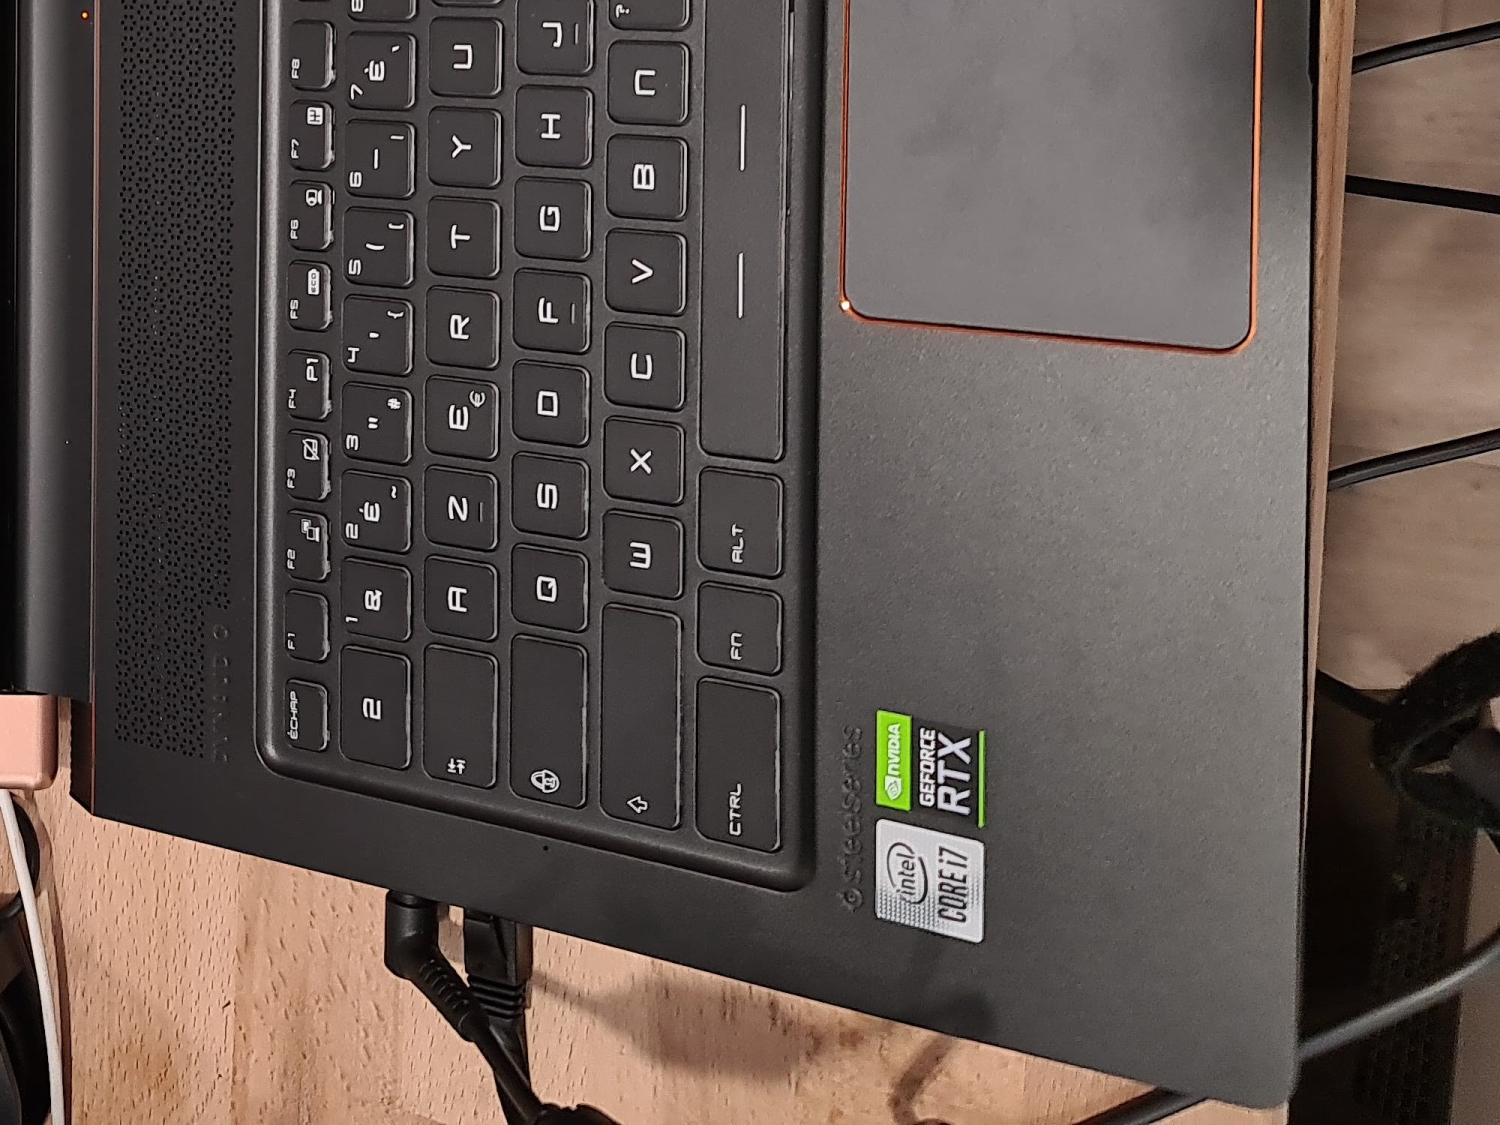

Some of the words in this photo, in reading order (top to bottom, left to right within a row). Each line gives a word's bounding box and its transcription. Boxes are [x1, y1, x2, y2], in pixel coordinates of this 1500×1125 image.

[543, 23, 562, 47] J
[292, 59, 299, 78] F8
[454, 45, 472, 68] U
[365, 61, 384, 80] È
[351, 85, 362, 99] 7
[542, 114, 560, 138] H
[291, 139, 299, 158] F7
[452, 136, 471, 158] Y
[350, 172, 361, 187] 6
[634, 164, 654, 189] B
[291, 220, 298, 239] F6
[540, 206, 559, 231] G
[451, 225, 470, 248] T
[349, 260, 361, 274] 5
[632, 260, 652, 283] V
[290, 300, 298, 319] F5
[539, 298, 558, 323] F
[450, 315, 469, 339] R
[348, 348, 359, 362] 4
[631, 354, 652, 379] C
[307, 359, 318, 381] P1
[289, 389, 296, 408] F4
[538, 391, 557, 416] D
[449, 405, 468, 430] E
[347, 435, 358, 450] 3
[631, 449, 651, 473] X
[287, 469, 295, 488] F3
[449, 496, 467, 520] Z
[537, 484, 557, 509] S
[360, 502, 379, 521] É
[346, 524, 358, 538] 2
[732, 525, 743, 562] ALT
[287, 549, 295, 569] F2
[448, 587, 466, 612] A
[537, 576, 556, 601] Q
[288, 633, 295, 649] F1
[731, 633, 742, 660] FN
[288, 691, 298, 739] ÉCHAP
[887, 723, 900, 776] NVIDIA
[919, 728, 936, 806] GEFORCE
[937, 732, 972, 815] RTX
[730, 784, 741, 835] CTRL
[937, 846, 968, 869] i7
[896, 853, 916, 897] intel
[938, 869, 967, 923] CORE
